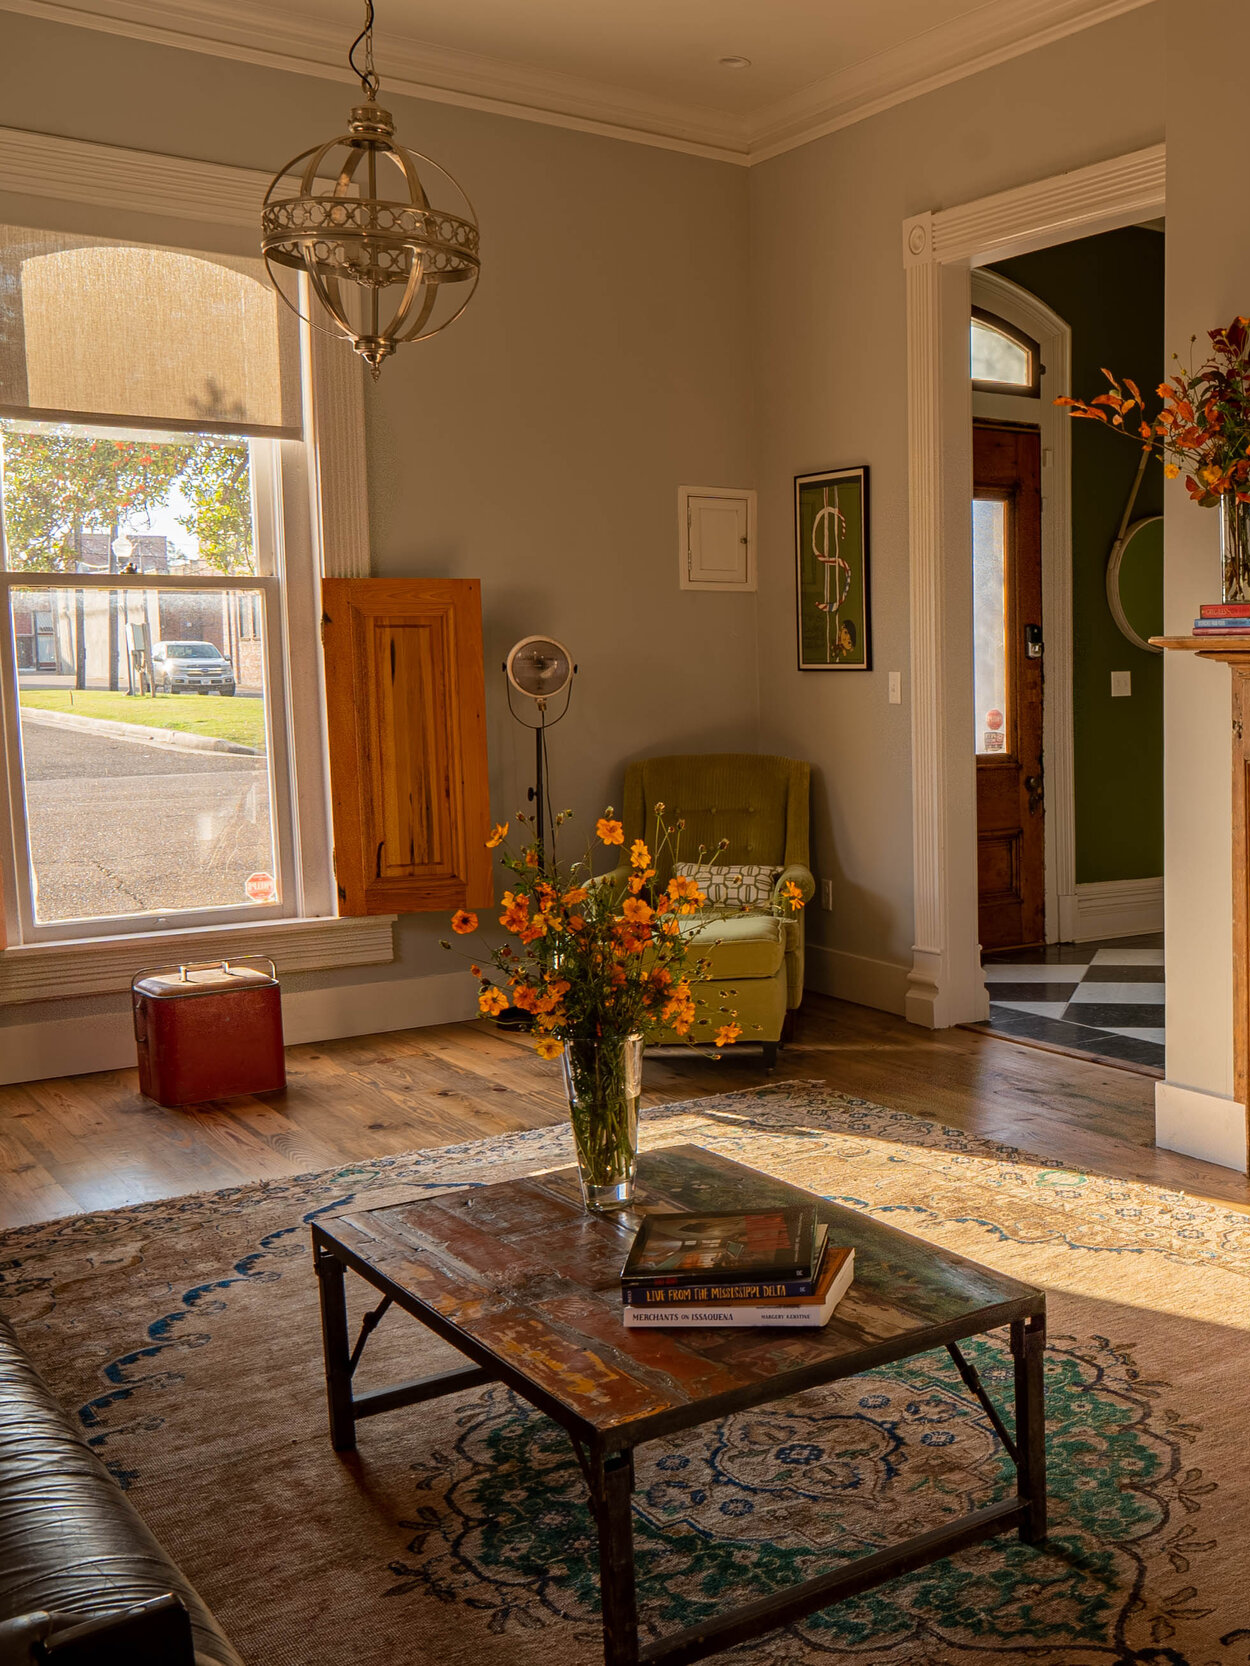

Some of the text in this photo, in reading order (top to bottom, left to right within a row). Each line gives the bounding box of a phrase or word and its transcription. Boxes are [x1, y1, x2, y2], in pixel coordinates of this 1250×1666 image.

[646, 1290, 665, 1302] LIVE
[668, 1289, 691, 1301] FROM
[694, 1288, 708, 1300] THE
[711, 1286, 760, 1299] MISSISSIPPI
[763, 1284, 787, 1297] DELTA
[632, 1313, 679, 1321] MERCHANTS
[691, 1313, 734, 1321] ISSAQUENA
